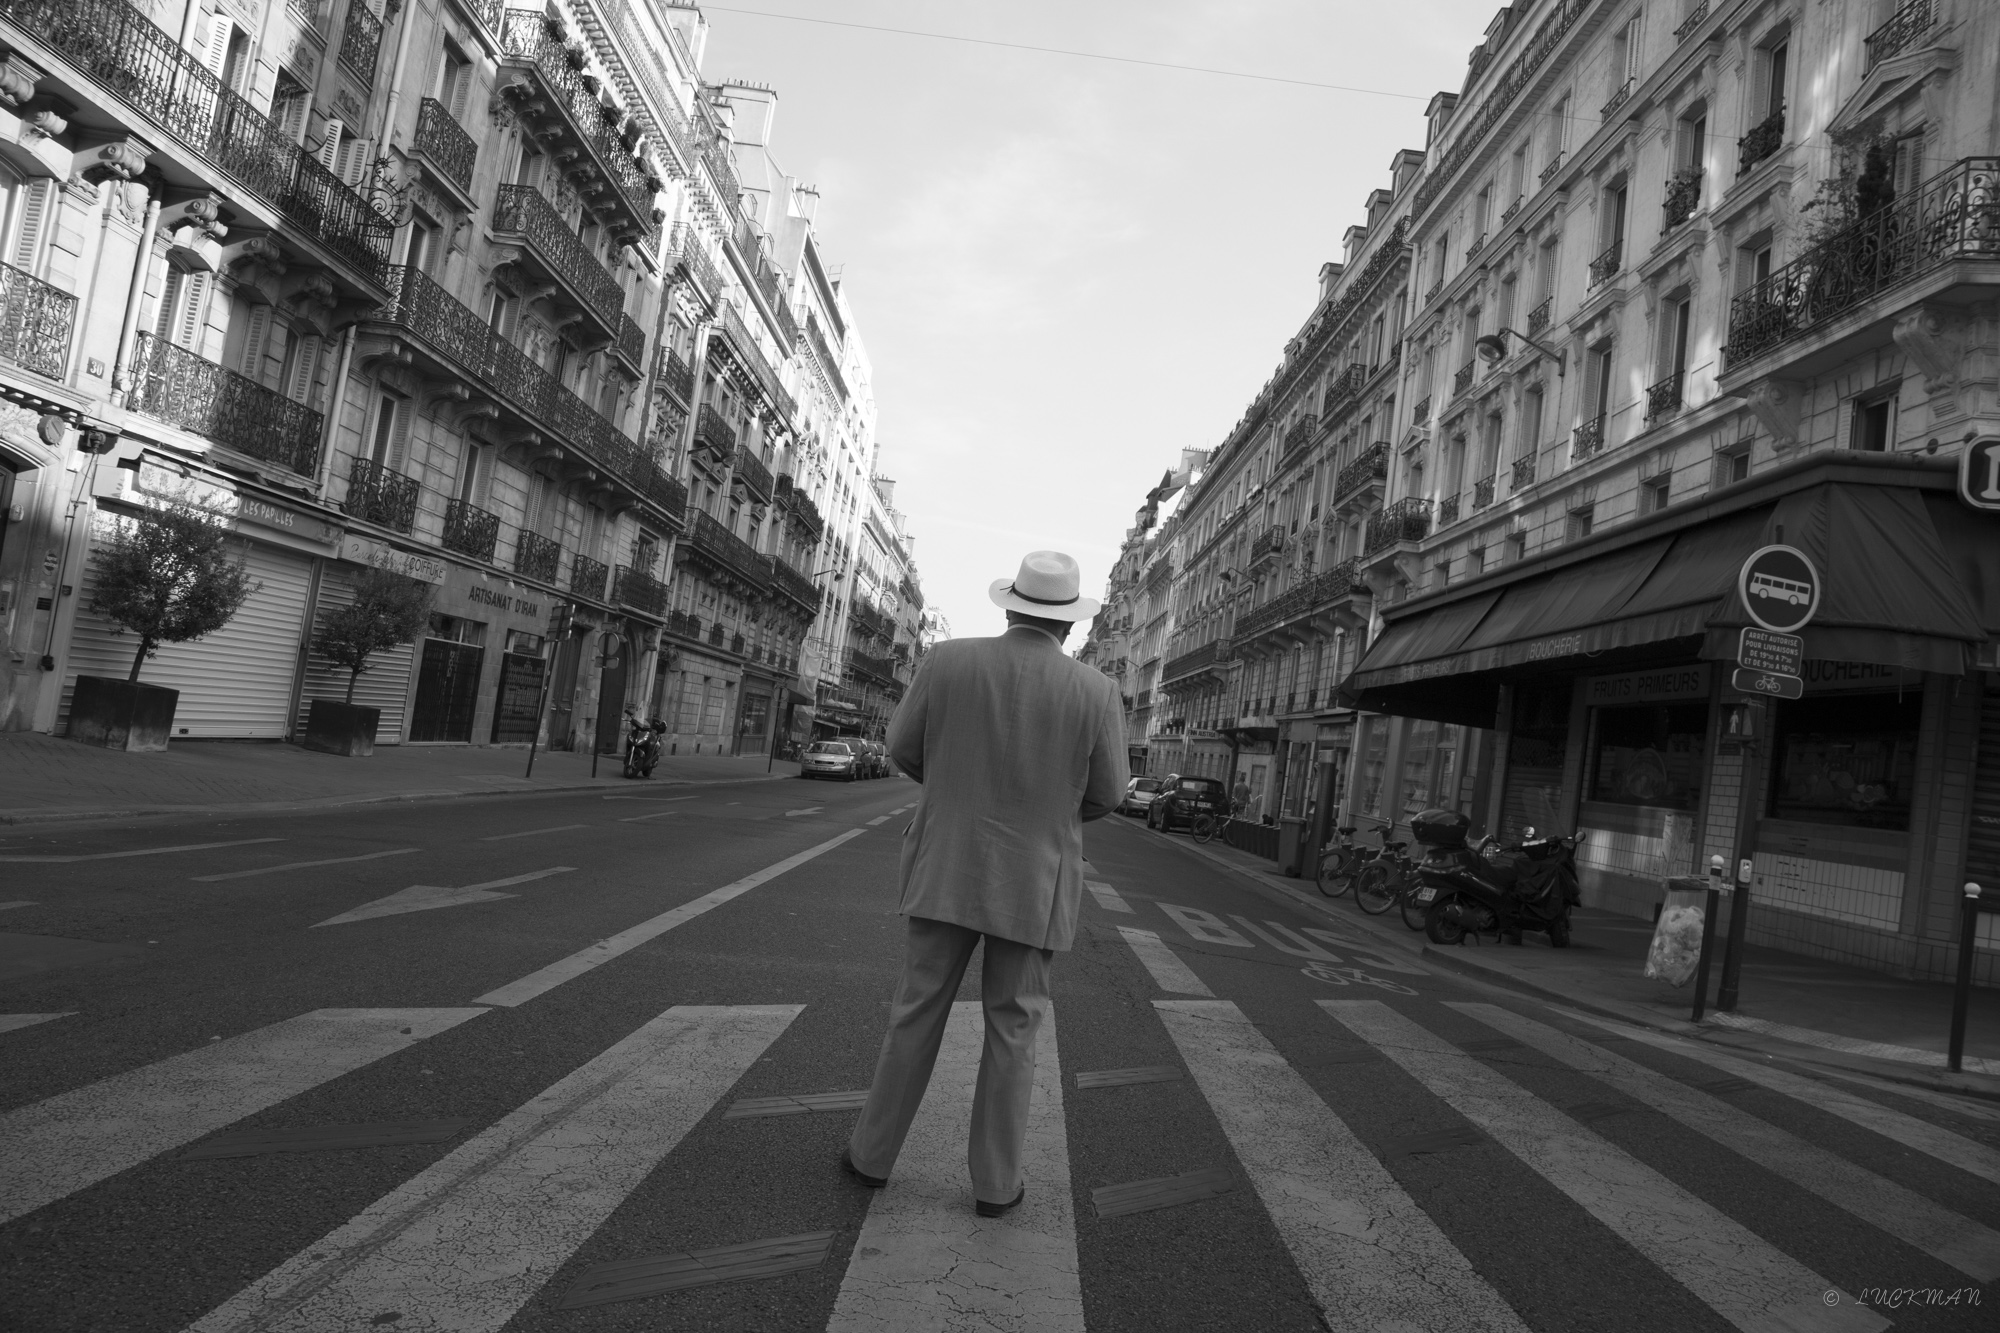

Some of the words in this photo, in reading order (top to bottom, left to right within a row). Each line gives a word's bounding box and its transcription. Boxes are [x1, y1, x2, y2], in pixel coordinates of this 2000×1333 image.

[90, 360, 103, 376] 30
[243, 500, 260, 516] LES
[409, 557, 443, 579] COIFFURE
[468, 586, 512, 610] ARTISANAT
[515, 599, 538, 617] D'IRAN
[1748, 631, 1768, 641] ARRÊT
[1529, 634, 1582, 659] BOUCHERIE
[1745, 640, 1762, 649] POUR
[1763, 643, 1799, 656] LIVRAISONS
[1749, 649, 1758, 658] DE
[1744, 657, 1752, 665] ET
[1752, 659, 1761, 667] DE
[1801, 659, 1893, 683] OUCHERIE
[1593, 678, 1631, 698] FRUITS
[1636, 671, 1700, 695] PRIMEURS
[1154, 902, 1431, 976] BUS
